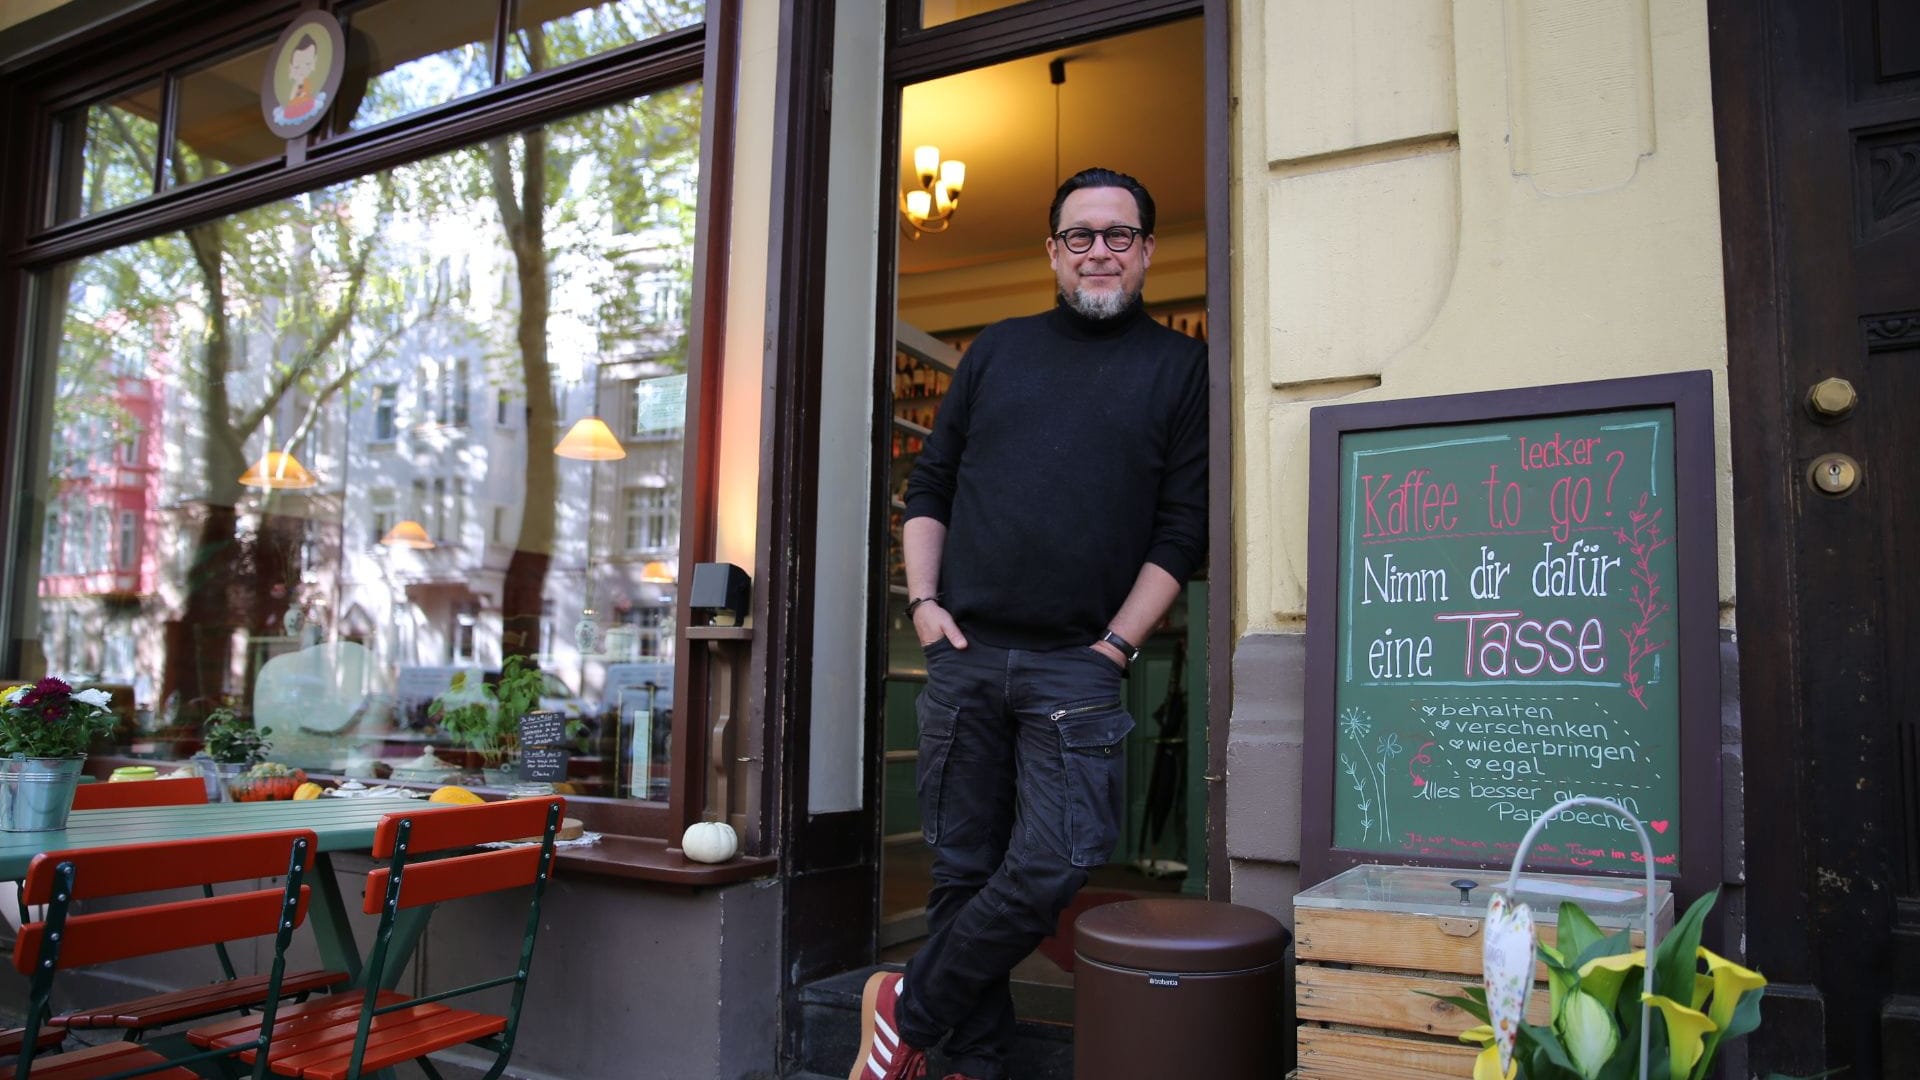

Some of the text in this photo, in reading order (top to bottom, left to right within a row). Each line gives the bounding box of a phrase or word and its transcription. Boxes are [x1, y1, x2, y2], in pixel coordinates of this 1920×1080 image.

[1519, 432, 1601, 471] lecker
[1361, 468, 1458, 538] Kaffee
[1482, 464, 1521, 529] to
[1361, 539, 1620, 605] Nimm dir dafür
[1368, 610, 1608, 679] eine Tasse
[1442, 702, 1554, 720] behalten
[1456, 719, 1608, 741] verschenken
[1467, 736, 1636, 769] wiederbringen
[1485, 756, 1546, 780] egal
[1412, 780, 1461, 801] Alles
[1470, 782, 1542, 801] besser
[1611, 849, 1626, 859] im
